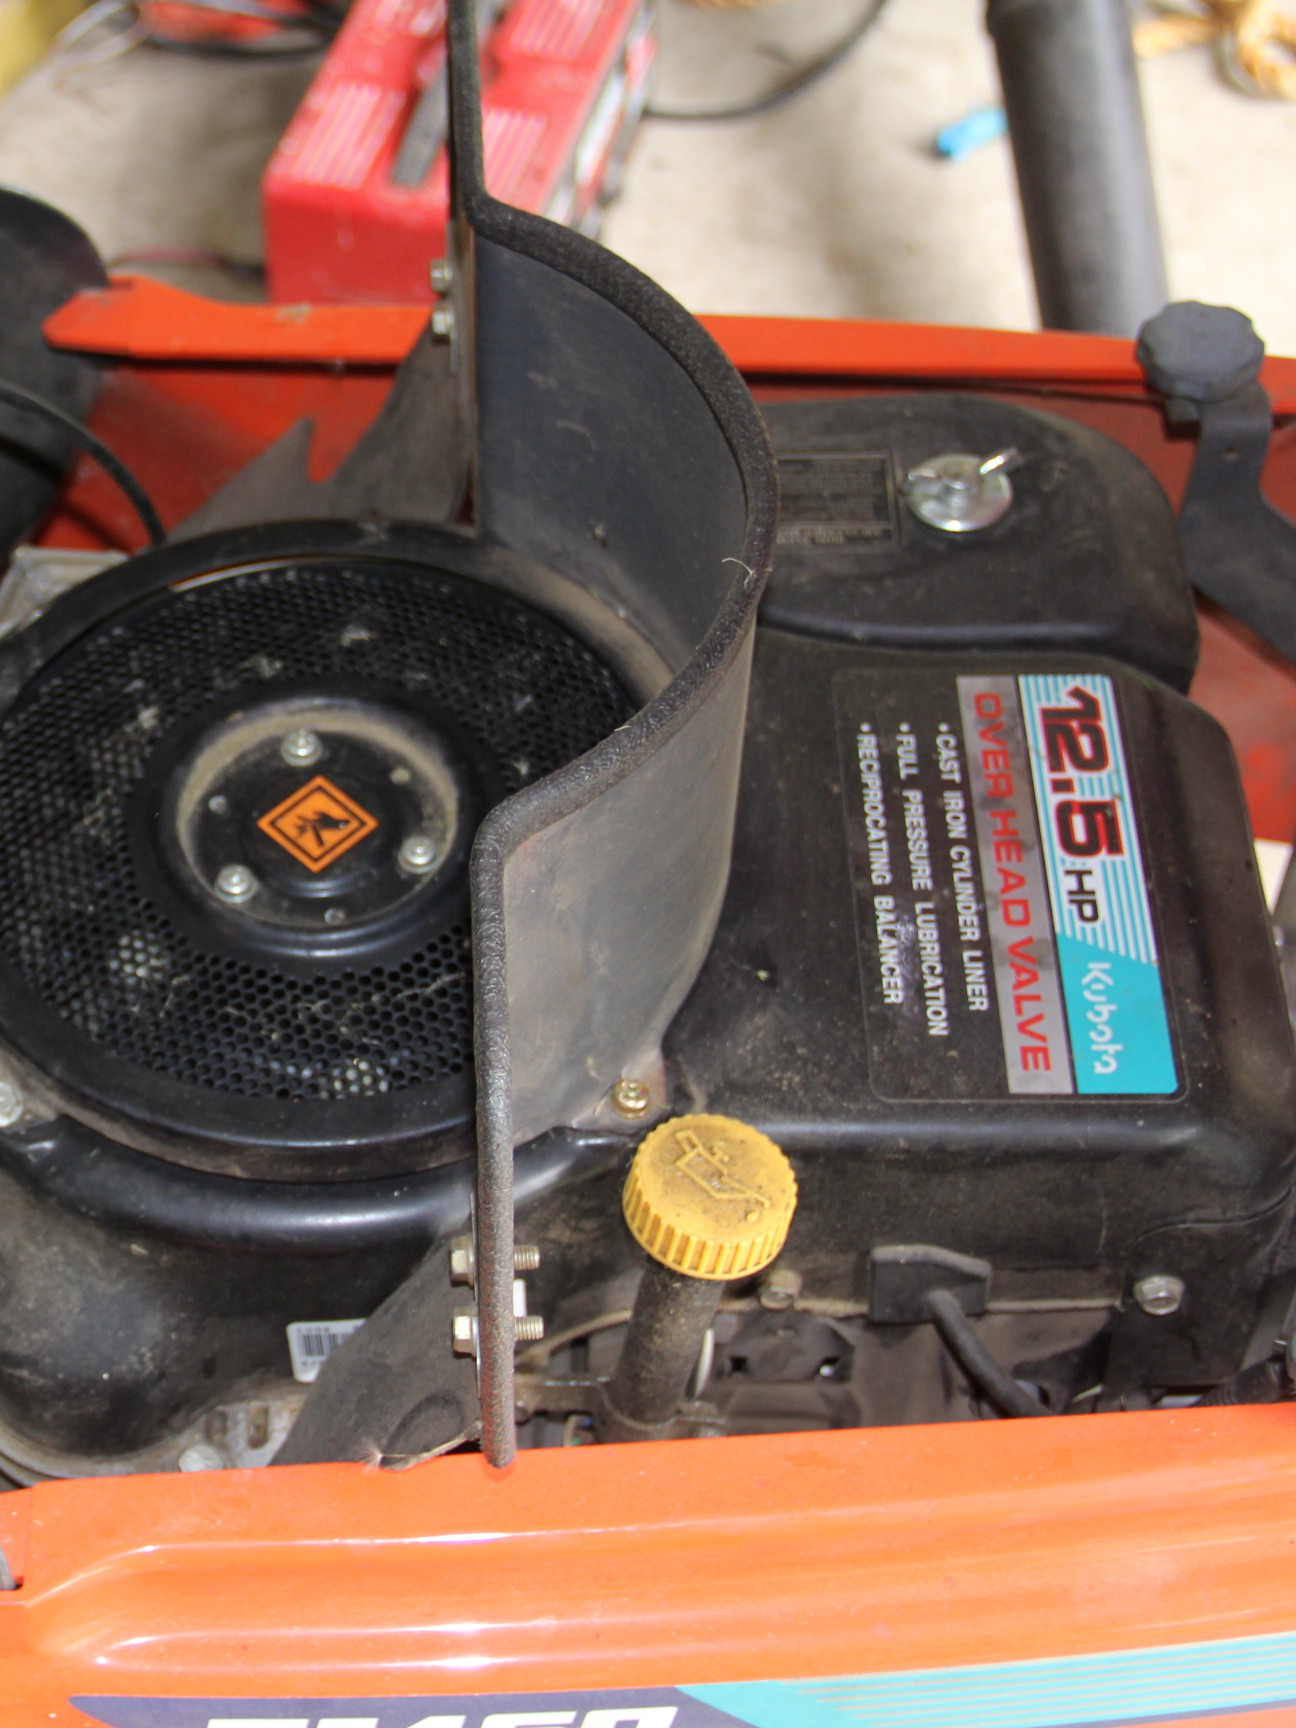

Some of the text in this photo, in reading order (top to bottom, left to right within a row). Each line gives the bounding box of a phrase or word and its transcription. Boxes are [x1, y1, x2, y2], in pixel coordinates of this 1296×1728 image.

[856, 733, 904, 1005] RECIPROCATING BALANCER
[896, 733, 950, 1036] FULL PRESSURE LUBRICATION
[935, 733, 990, 1012] CAST IRON CYLINDER LINER
[973, 692, 1052, 1072] OVER HEAD VALVE
[1039, 685, 1126, 924] 12.5 HP
[1080, 961, 1124, 1075] Kubota
